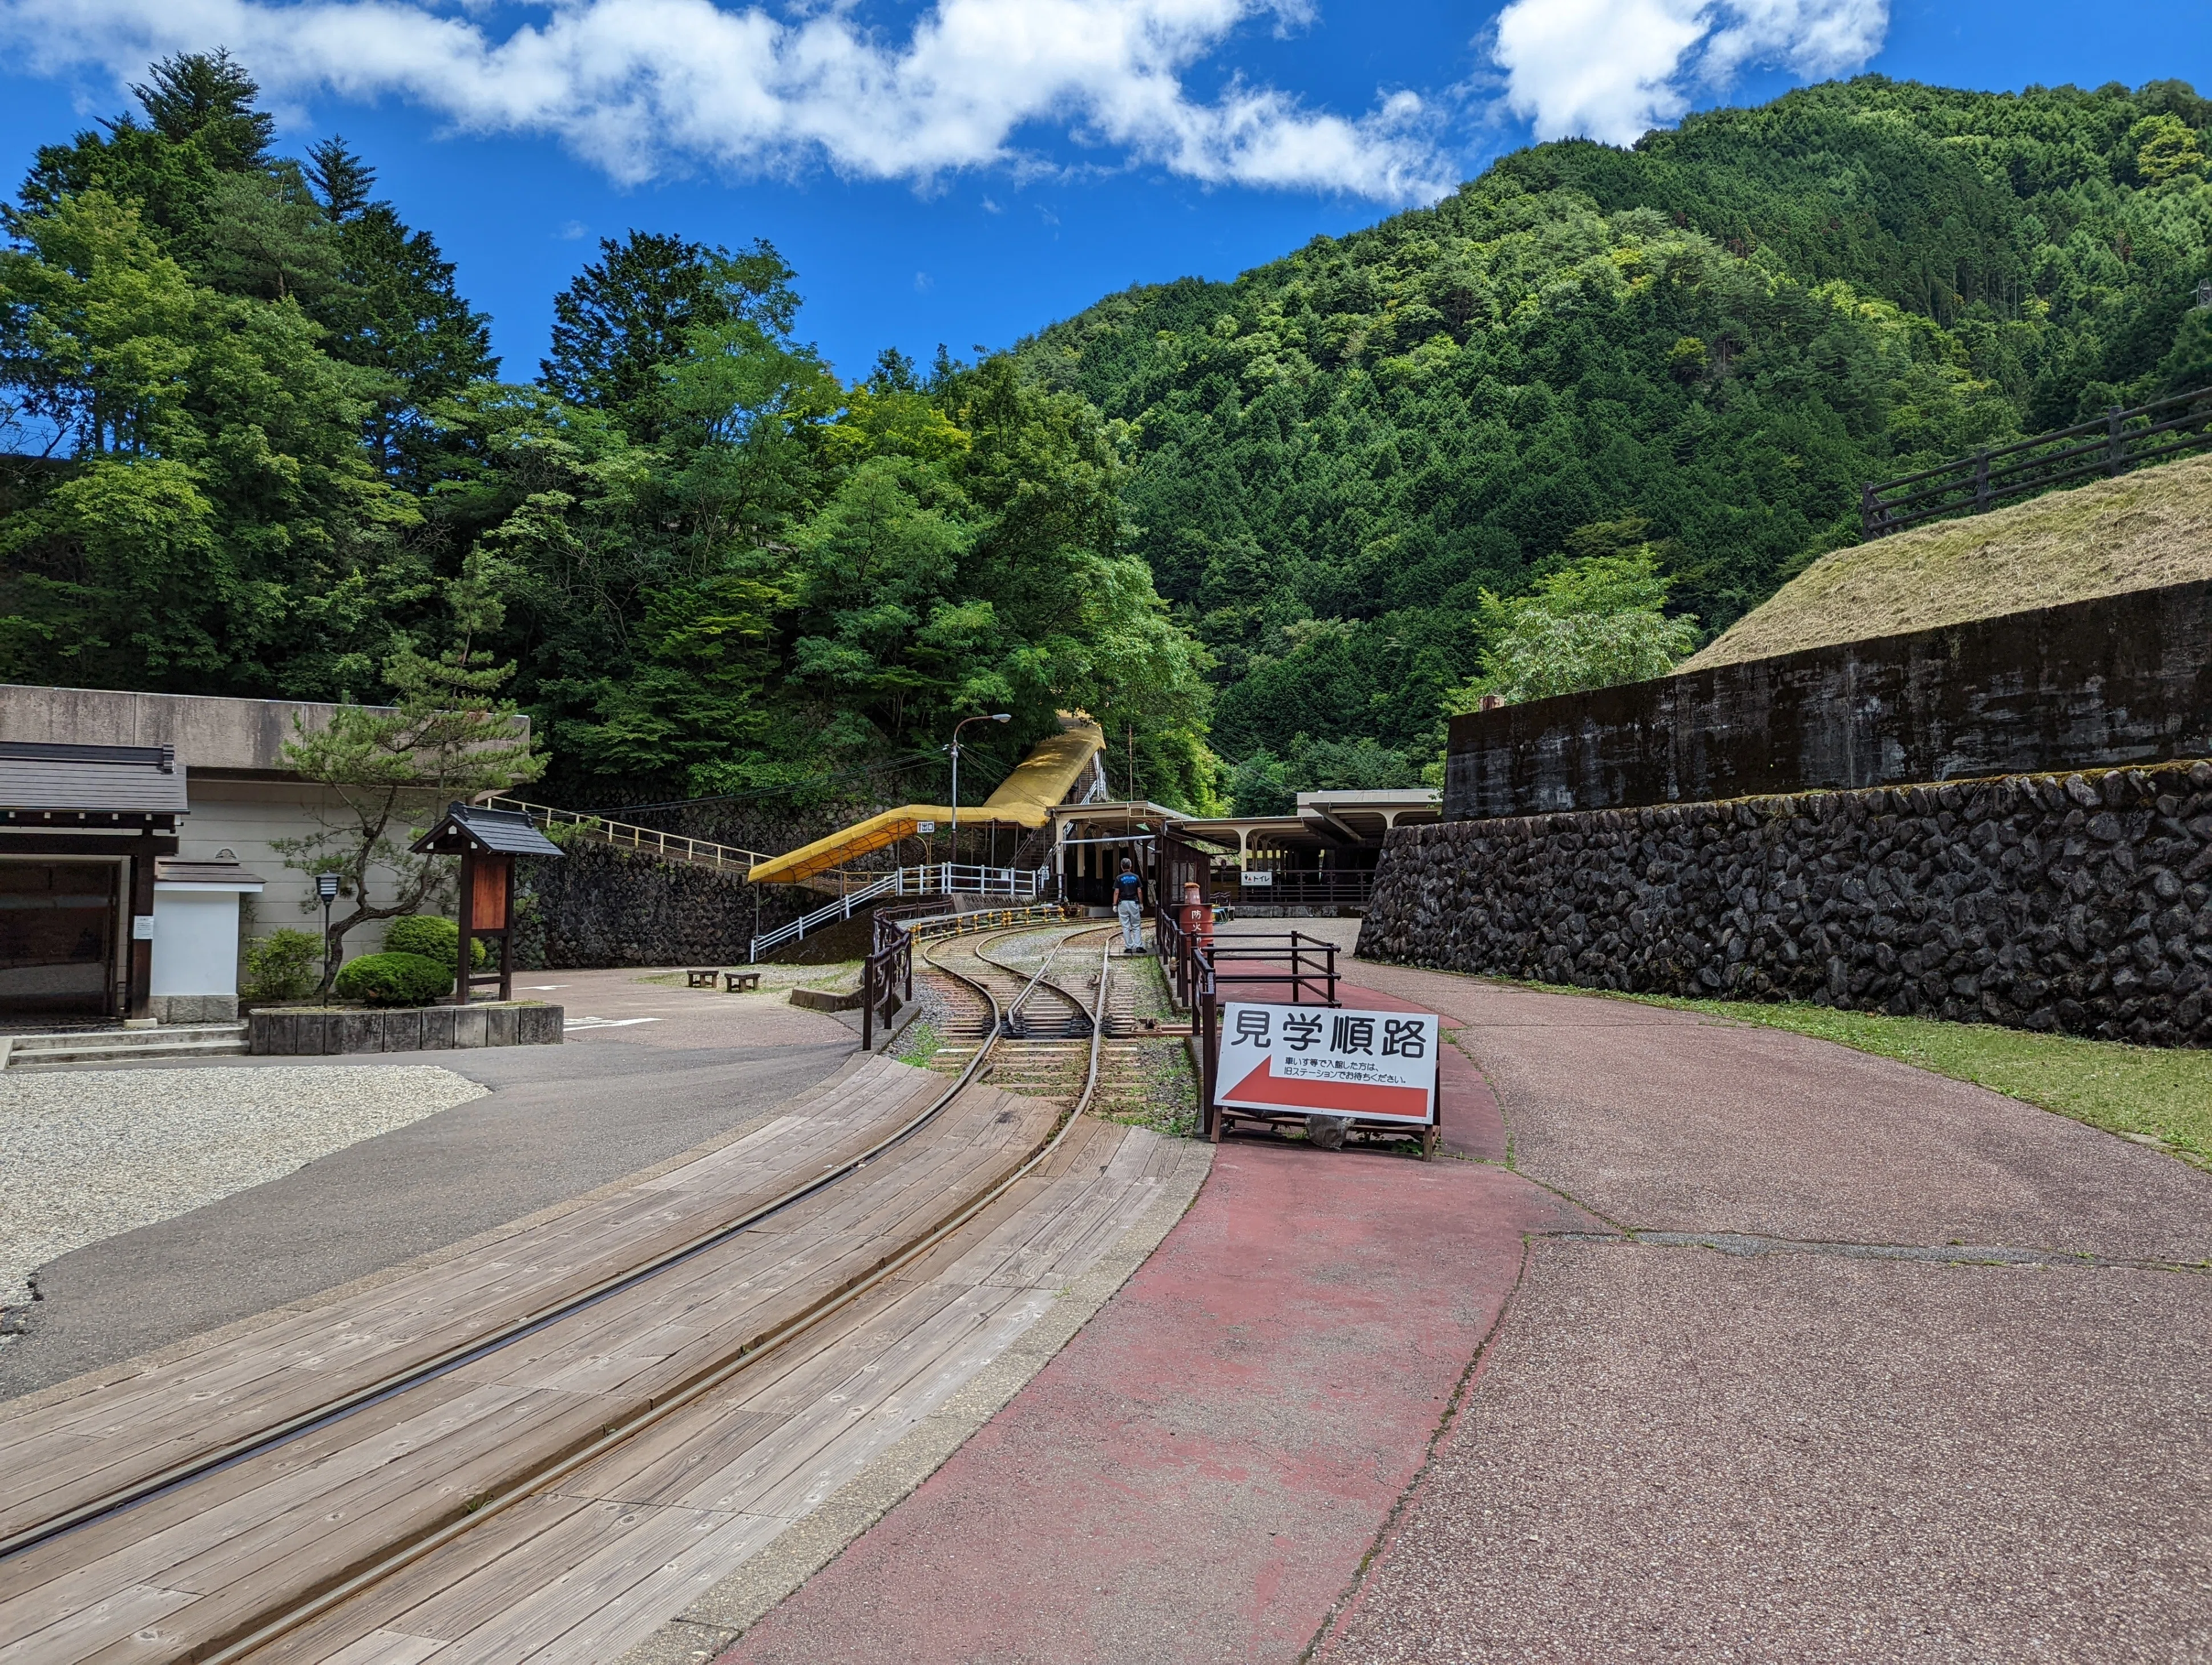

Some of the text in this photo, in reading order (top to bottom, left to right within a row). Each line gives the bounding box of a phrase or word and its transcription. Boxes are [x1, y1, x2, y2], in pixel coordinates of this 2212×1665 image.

[1230, 1009, 1426, 1058] 見学順路
[1285, 1057, 1379, 1072] 車いす等で入館した方は、
[1284, 1066, 1406, 1084] 旧ステーションでお待ちください。
